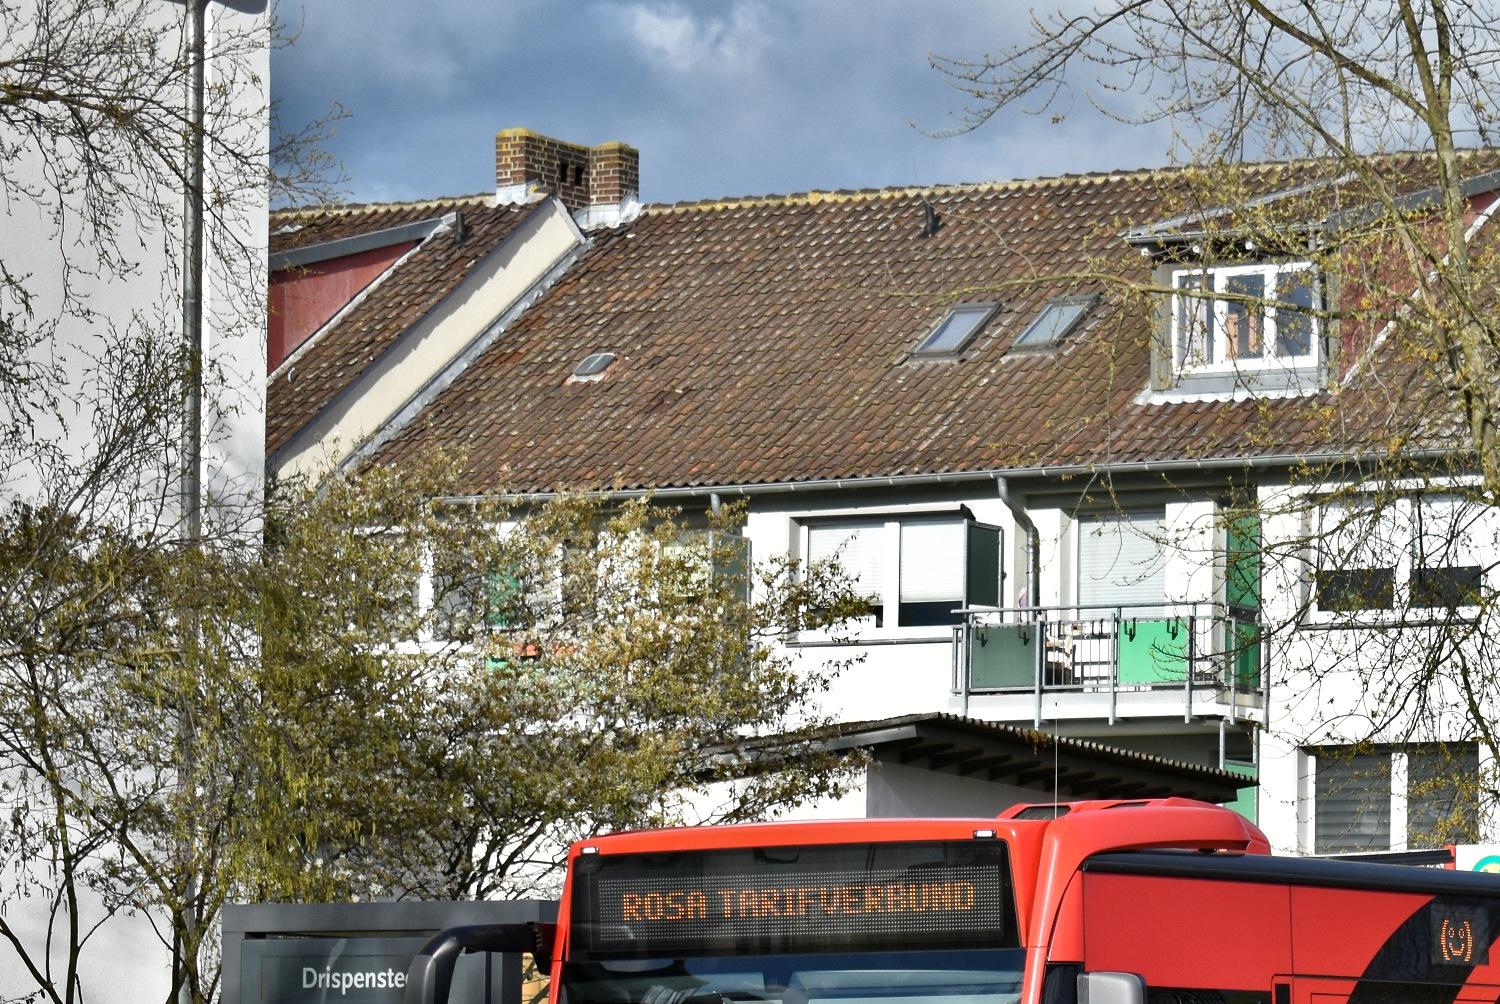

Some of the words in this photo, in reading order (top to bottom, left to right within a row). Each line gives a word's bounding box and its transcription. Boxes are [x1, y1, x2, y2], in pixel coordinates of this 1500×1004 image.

[622, 890, 706, 921] ROSA
[718, 880, 976, 919] TARIFVERBUND
[302, 965, 408, 995] Drispenste
